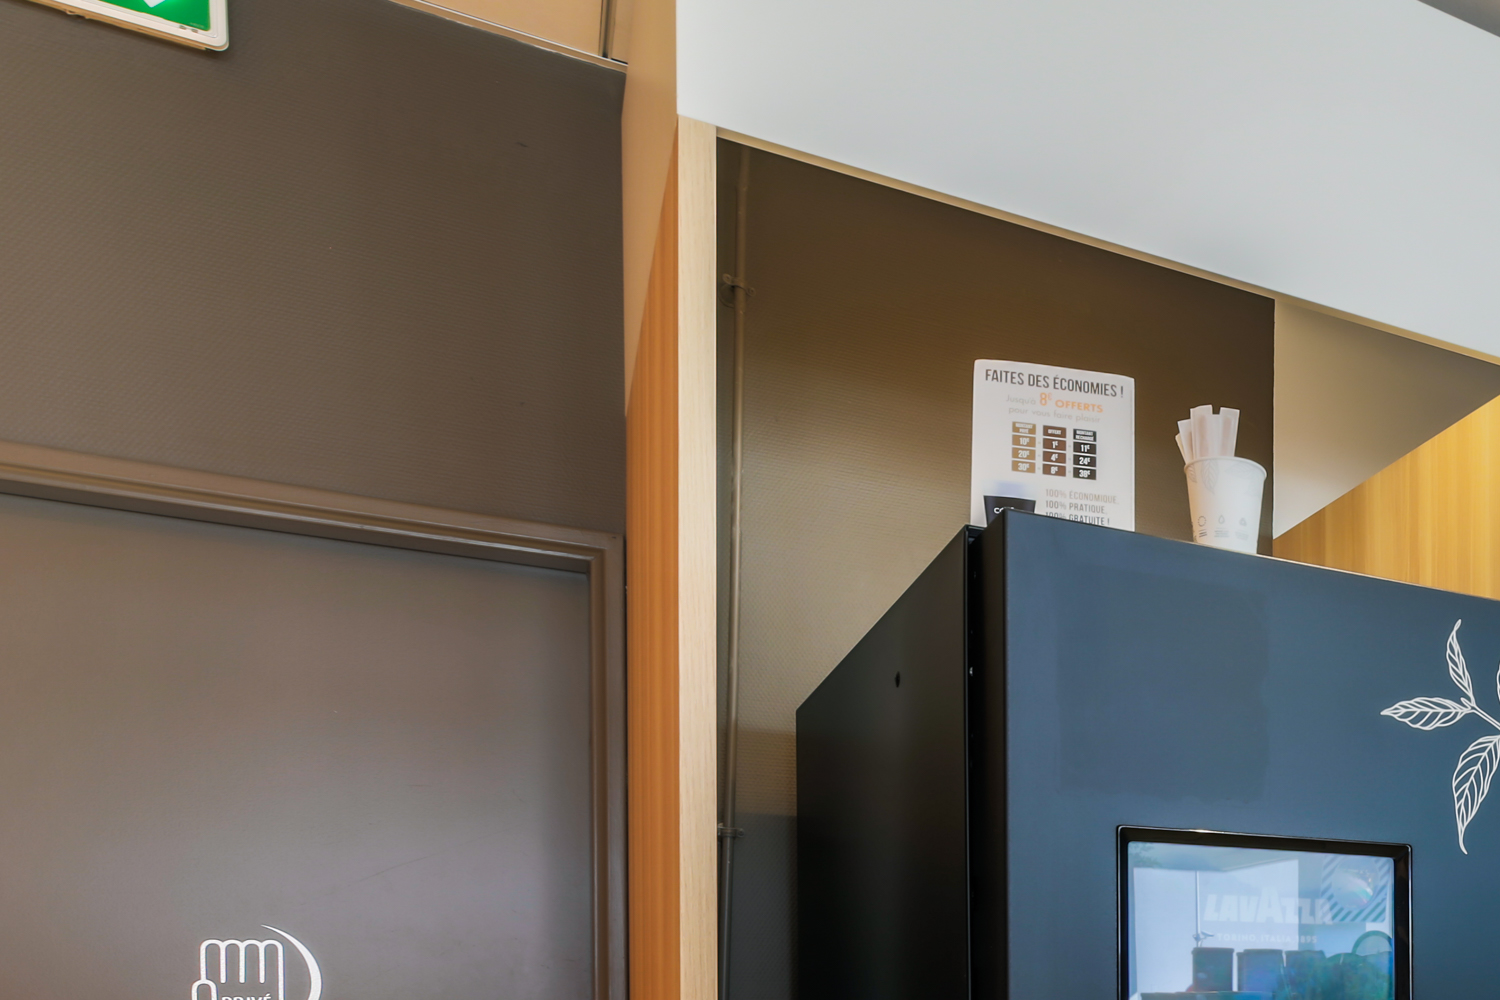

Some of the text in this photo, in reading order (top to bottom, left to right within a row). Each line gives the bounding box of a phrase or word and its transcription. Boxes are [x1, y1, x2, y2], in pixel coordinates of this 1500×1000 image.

[985, 369, 1124, 398] FAITES DES ÉCONOMIES !
[1055, 400, 1103, 413] OFFERTS
[1008, 407, 1028, 415] pour
[1053, 410, 1073, 420] faire
[1075, 414, 1101, 423] plaisir
[1045, 489, 1067, 498] 100%
[1045, 501, 1066, 510] 100%
